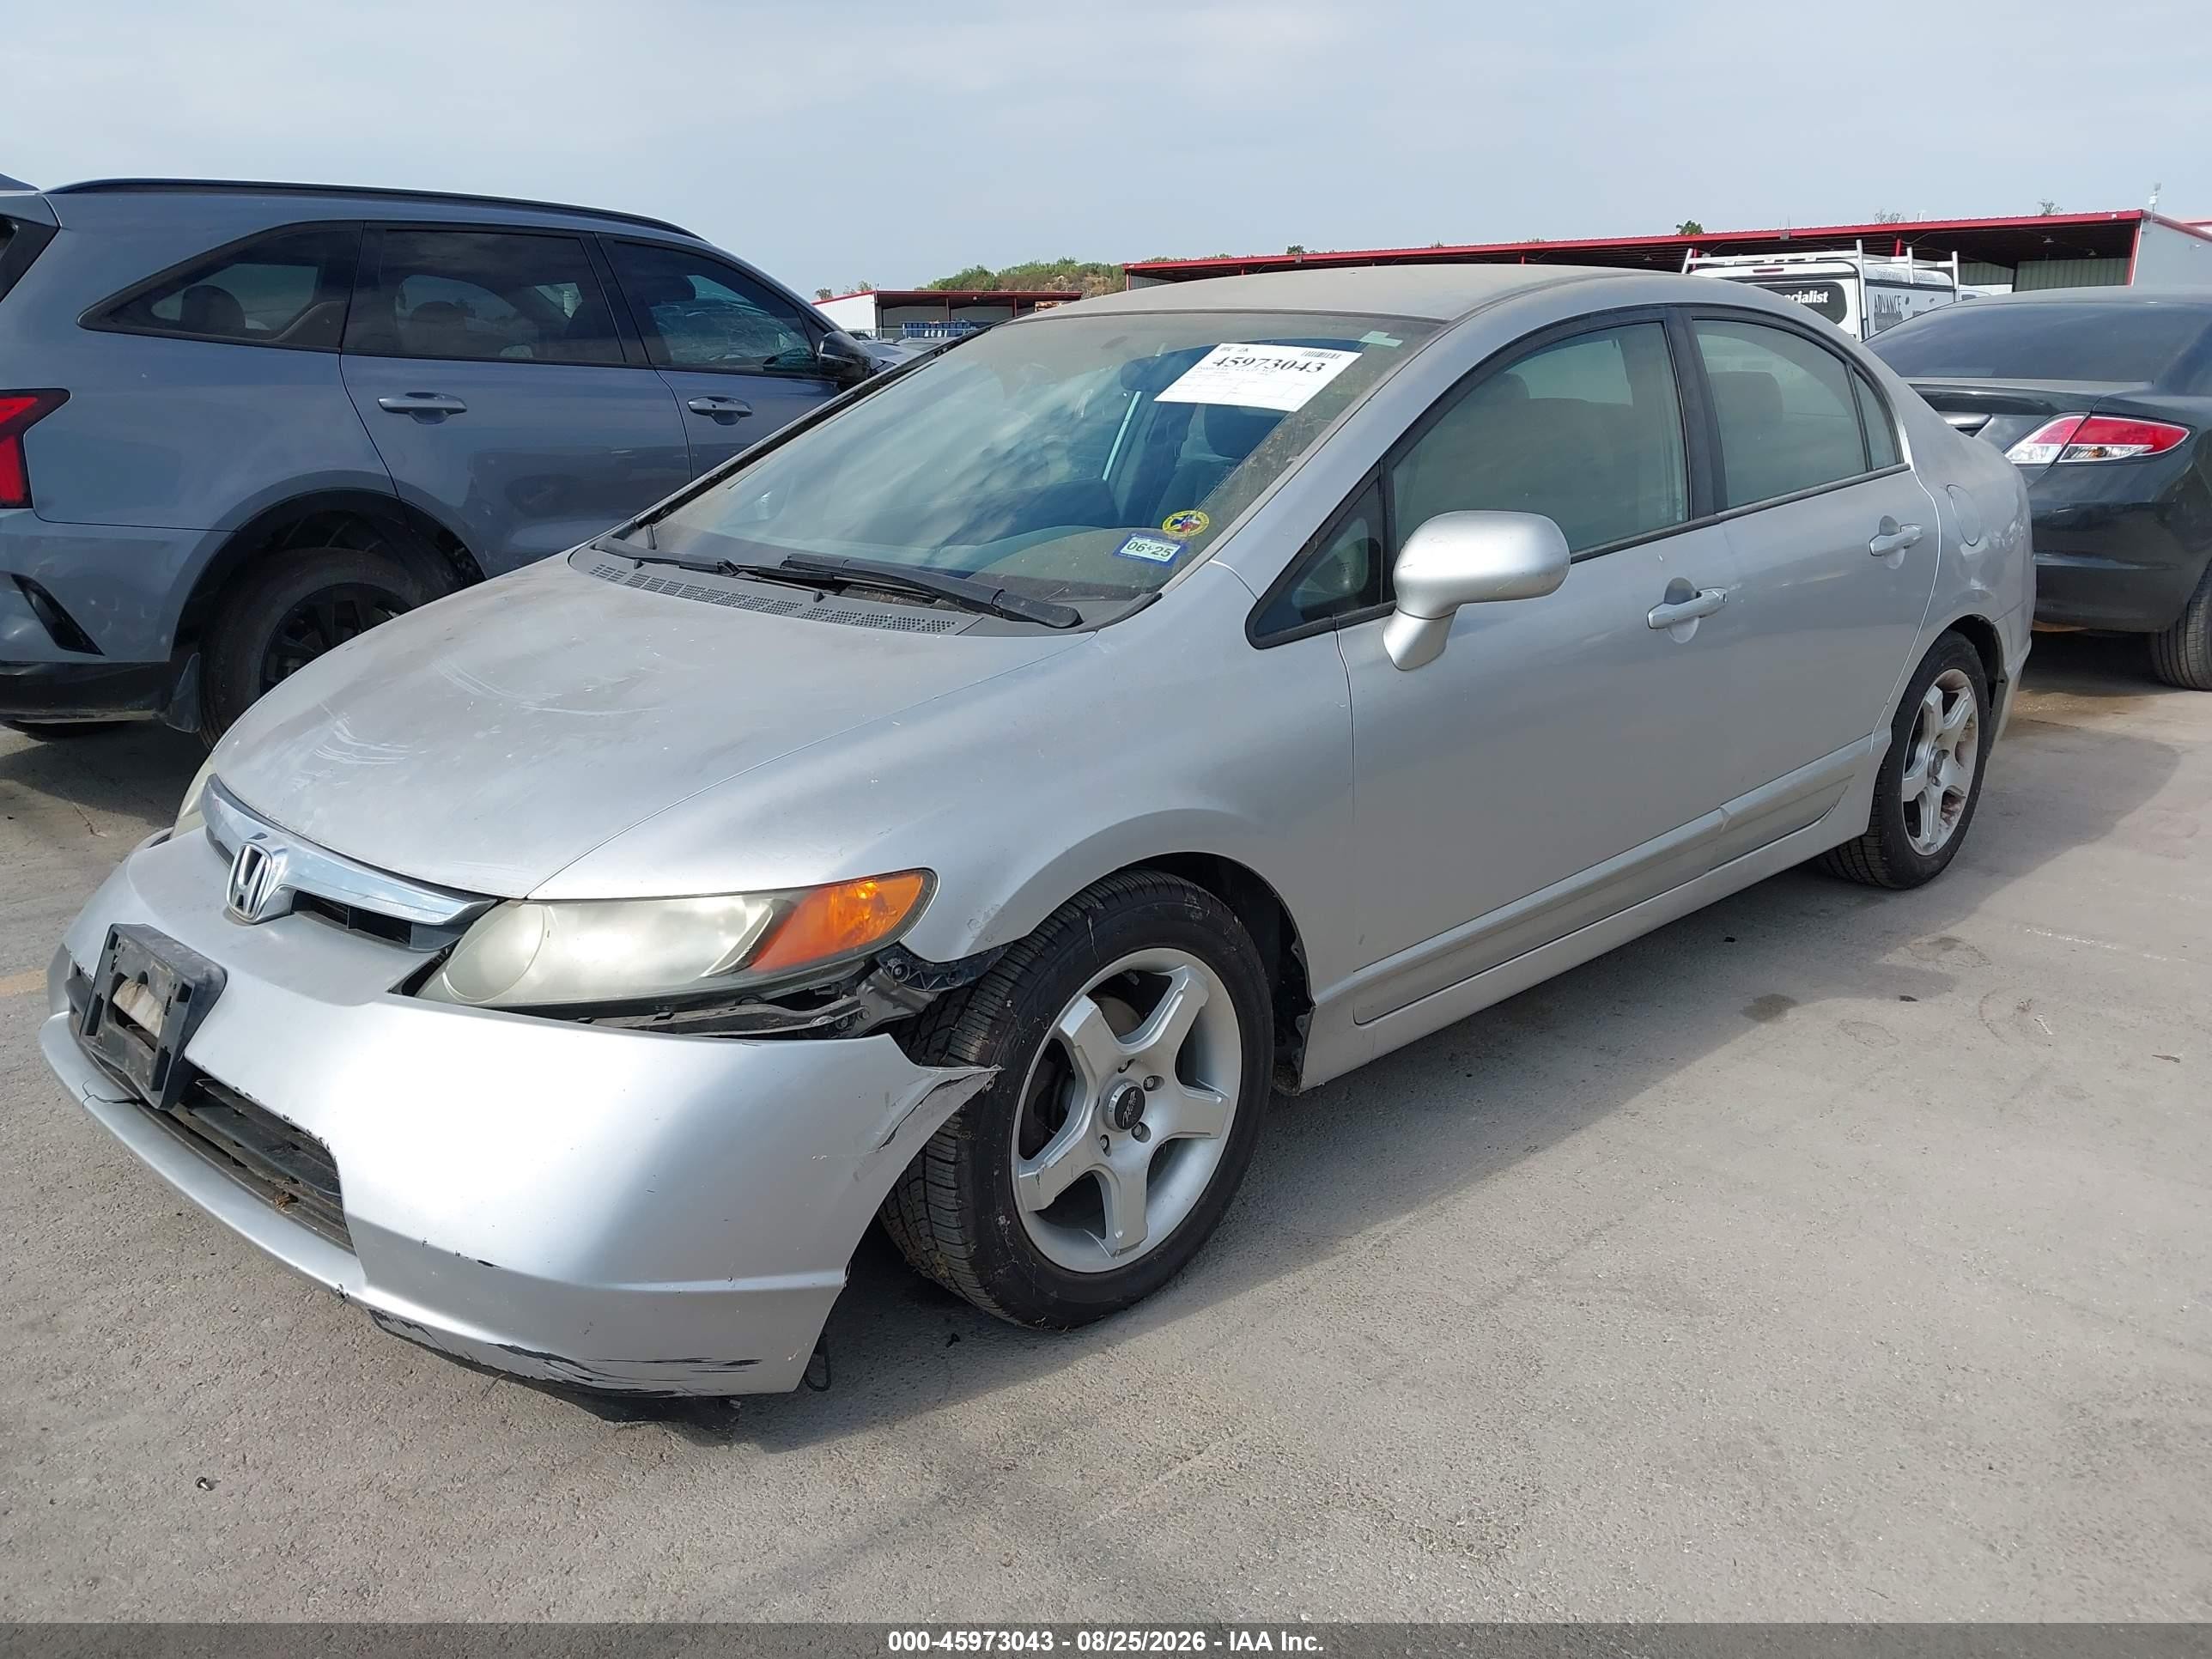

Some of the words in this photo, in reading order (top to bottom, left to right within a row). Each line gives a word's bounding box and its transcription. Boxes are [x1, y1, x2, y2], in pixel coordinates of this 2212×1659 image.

[1874, 294, 1902, 314] ADVANCE
[1212, 356, 1326, 373] 45973043
[1127, 541, 1148, 552] 06
[1152, 547, 1174, 557] 25
